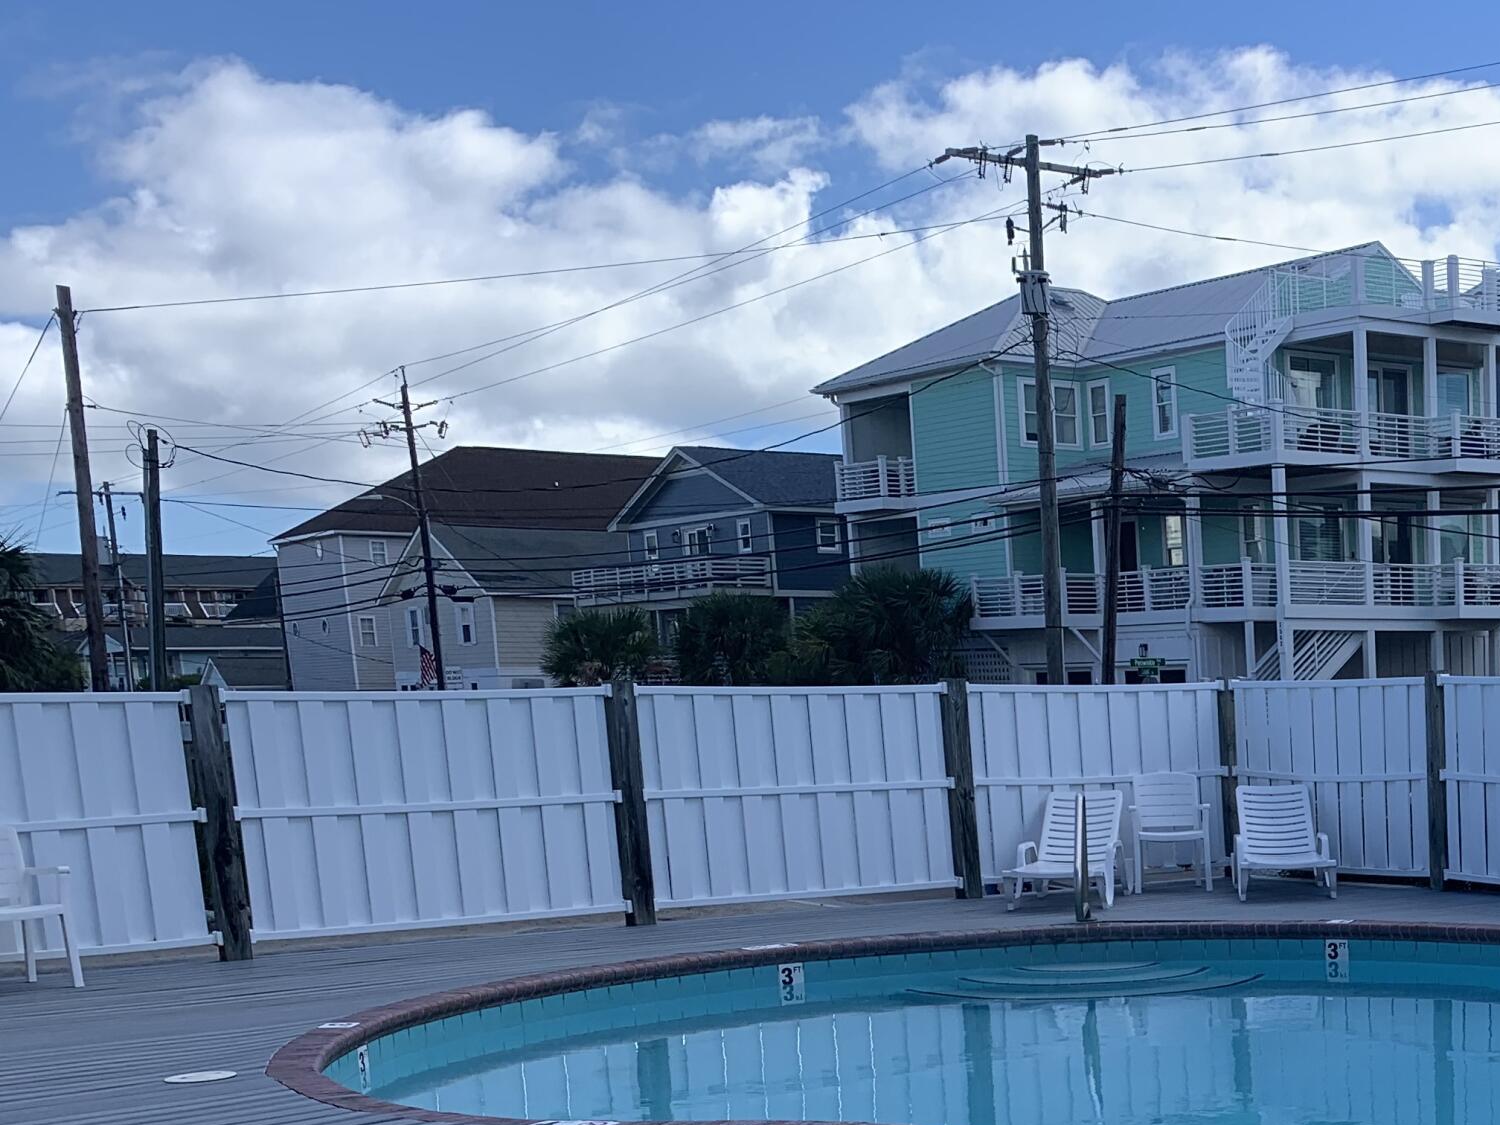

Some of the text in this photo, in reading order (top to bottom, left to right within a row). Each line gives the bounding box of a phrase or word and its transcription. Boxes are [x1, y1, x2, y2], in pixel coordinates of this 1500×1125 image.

[1328, 943, 1338, 960] 3
[781, 966, 801, 985] 3 FT
[359, 1051, 365, 1072] 3
